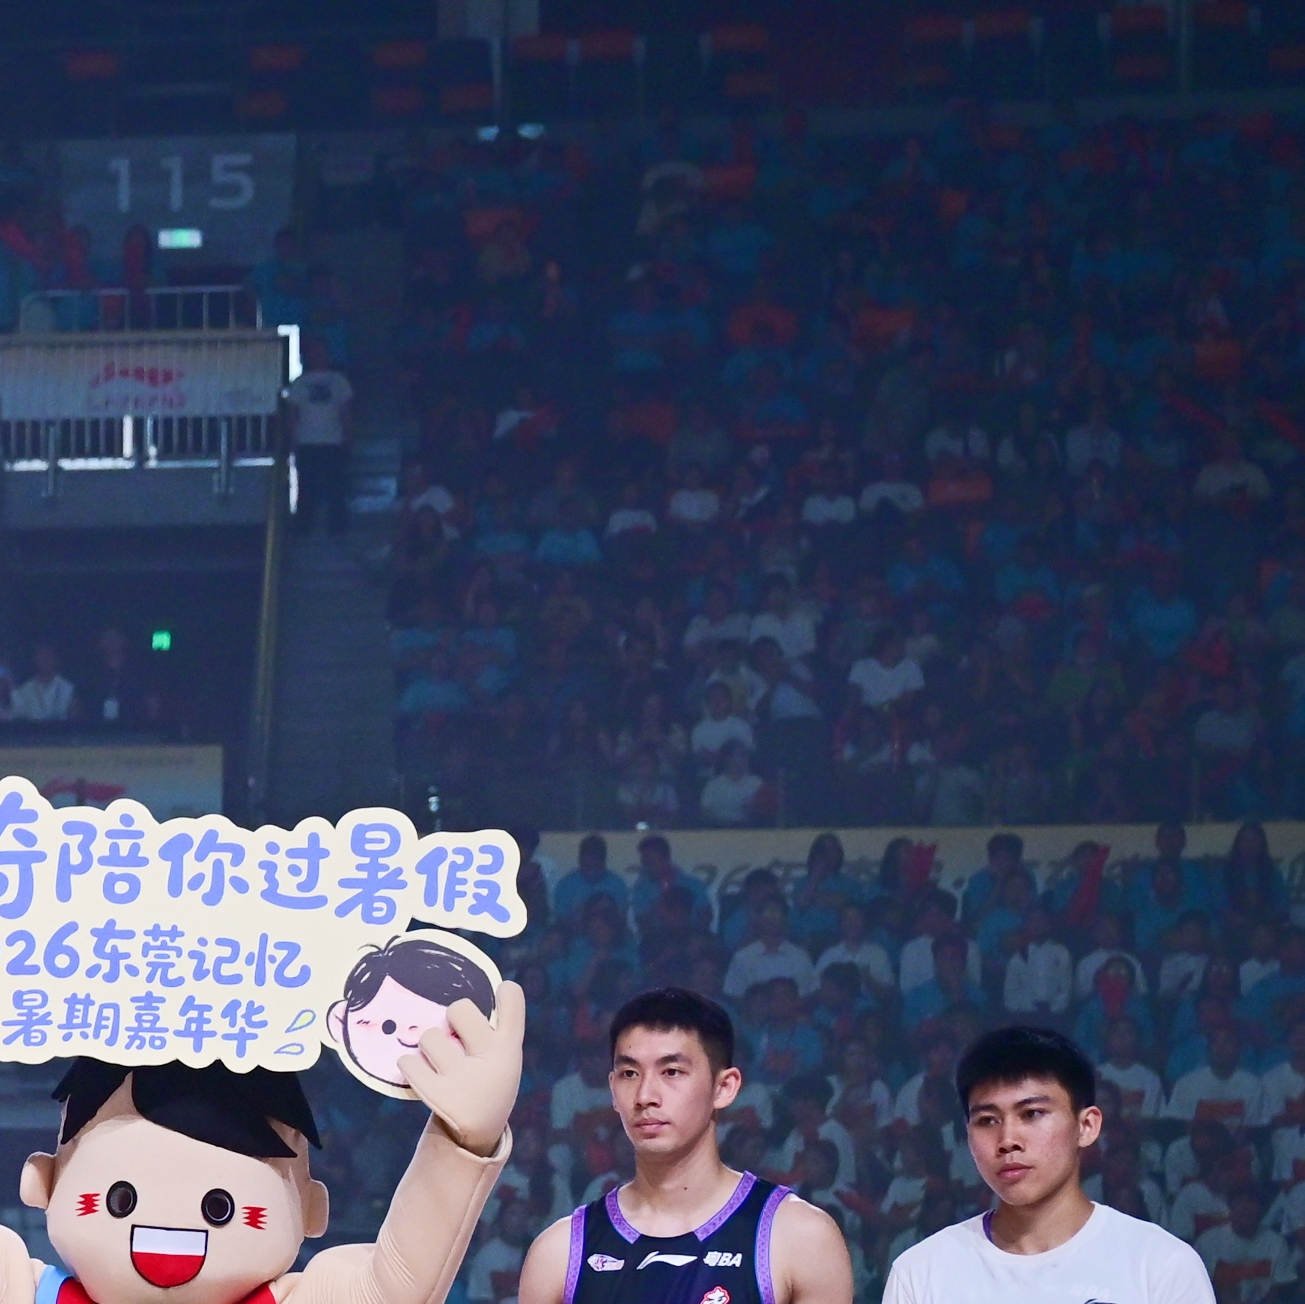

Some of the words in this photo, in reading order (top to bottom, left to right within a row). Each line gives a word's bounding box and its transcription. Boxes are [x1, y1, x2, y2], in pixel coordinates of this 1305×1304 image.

[108, 153, 256, 213] 115
[2, 989, 268, 1060] 暑期嘉年华
[703, 1251, 742, 1268] 粤BA
